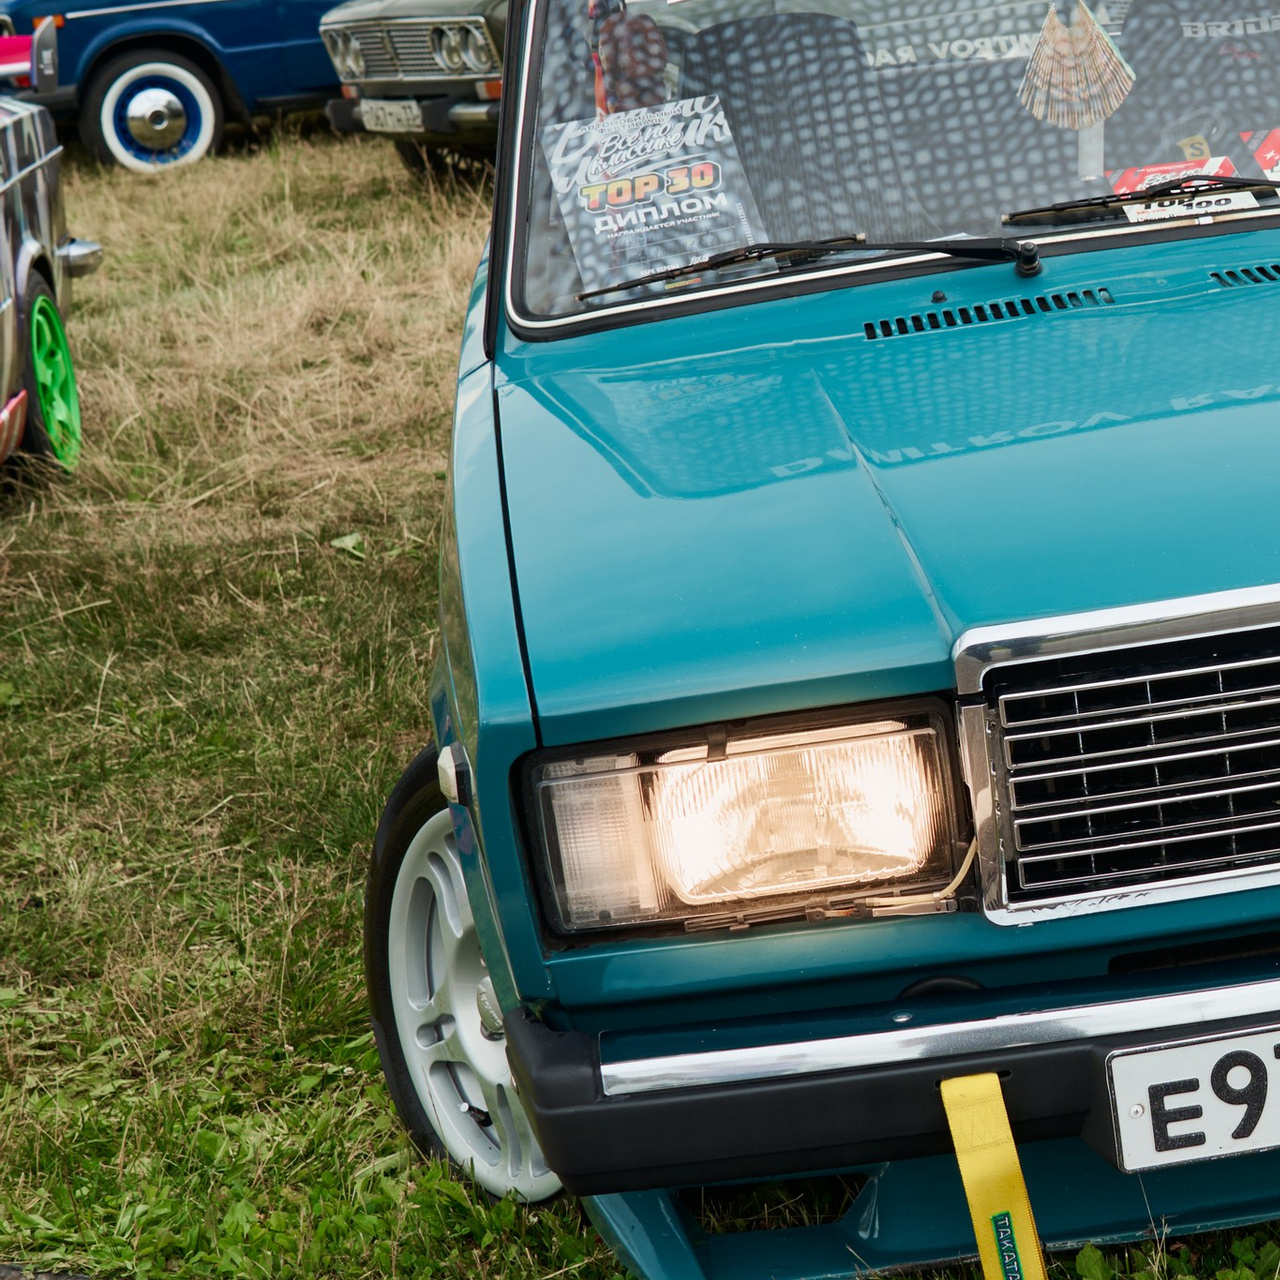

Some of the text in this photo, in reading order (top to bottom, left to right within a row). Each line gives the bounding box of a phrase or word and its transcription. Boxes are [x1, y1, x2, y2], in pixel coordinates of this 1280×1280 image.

[580, 163, 715, 210] TOP 30
[594, 192, 728, 236] ДИПЛОМ
[606, 211, 721, 239] НАГРАЖДАЕТСЯ УЧАСТНИК
